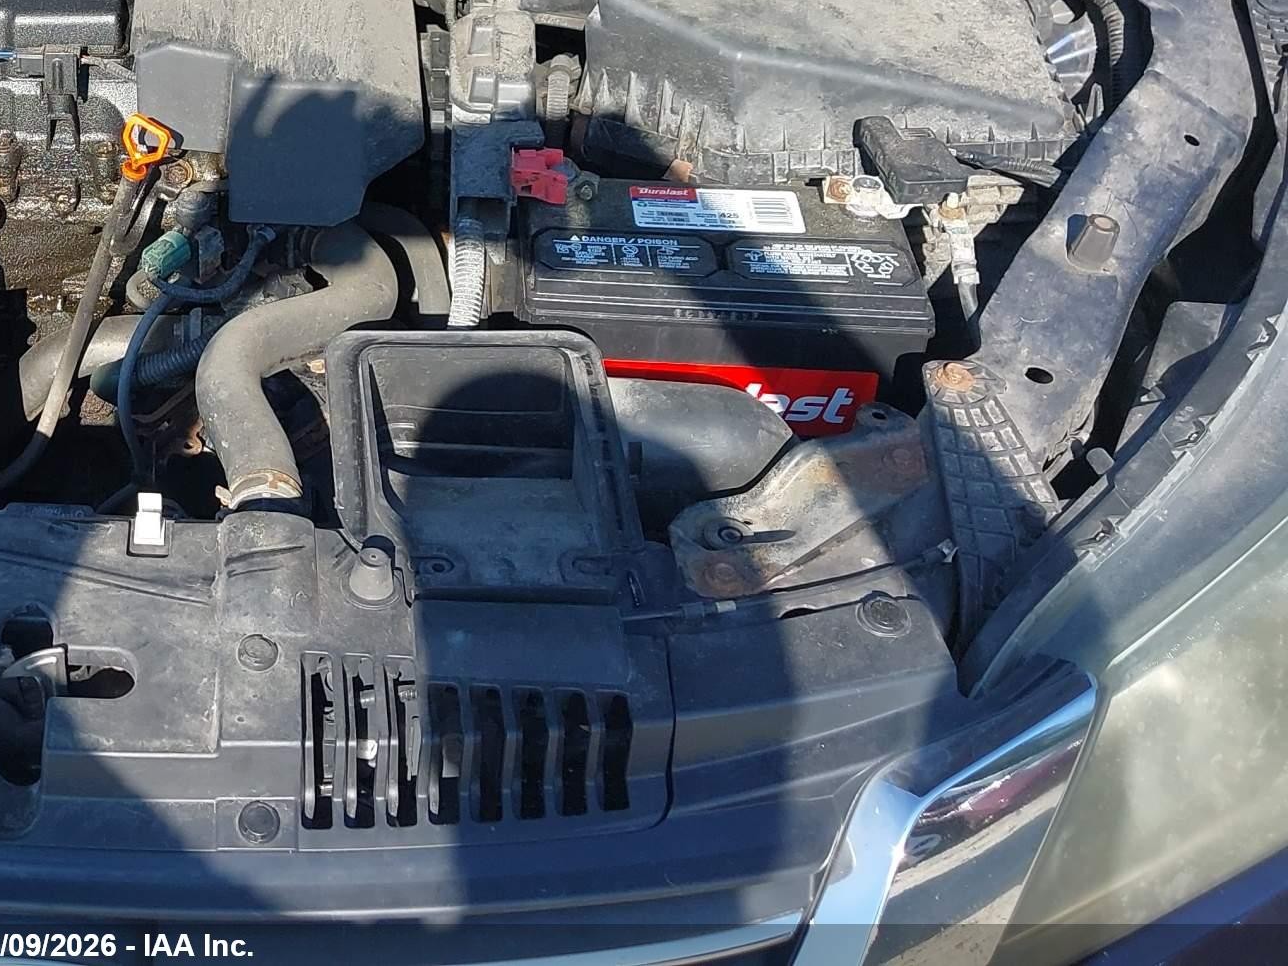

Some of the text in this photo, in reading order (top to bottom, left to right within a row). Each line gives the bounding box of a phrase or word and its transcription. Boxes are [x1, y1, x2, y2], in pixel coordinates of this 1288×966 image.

[637, 187, 689, 196] Duralast
[582, 236, 627, 244] DANGER
[637, 238, 678, 246] POISON
